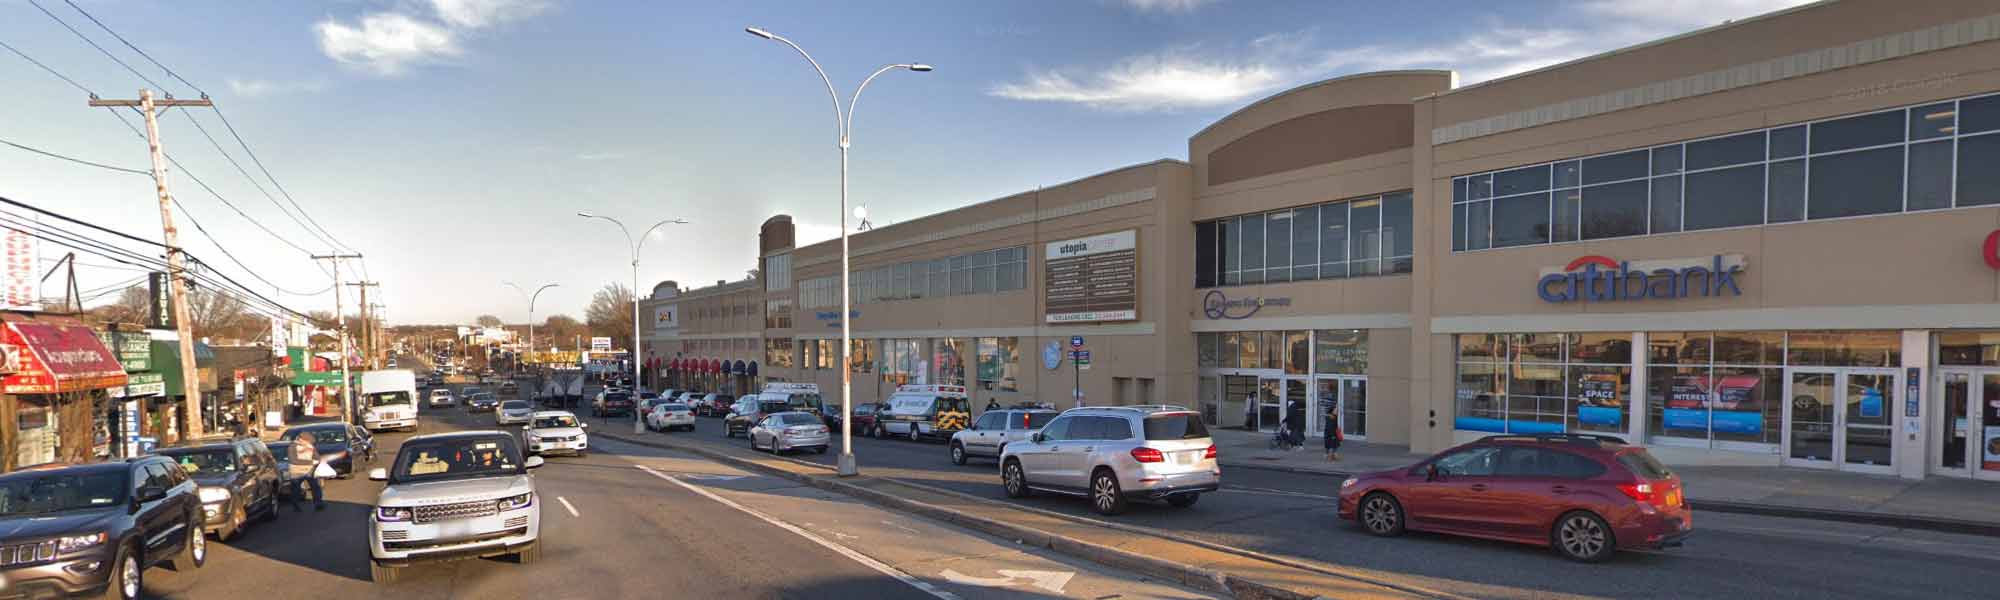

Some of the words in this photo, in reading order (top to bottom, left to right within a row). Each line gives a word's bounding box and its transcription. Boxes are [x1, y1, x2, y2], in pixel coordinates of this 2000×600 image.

[1060, 240, 1087, 255] utopia
[1537, 255, 1742, 303] citibank
[1585, 390, 1615, 399] SPACE
